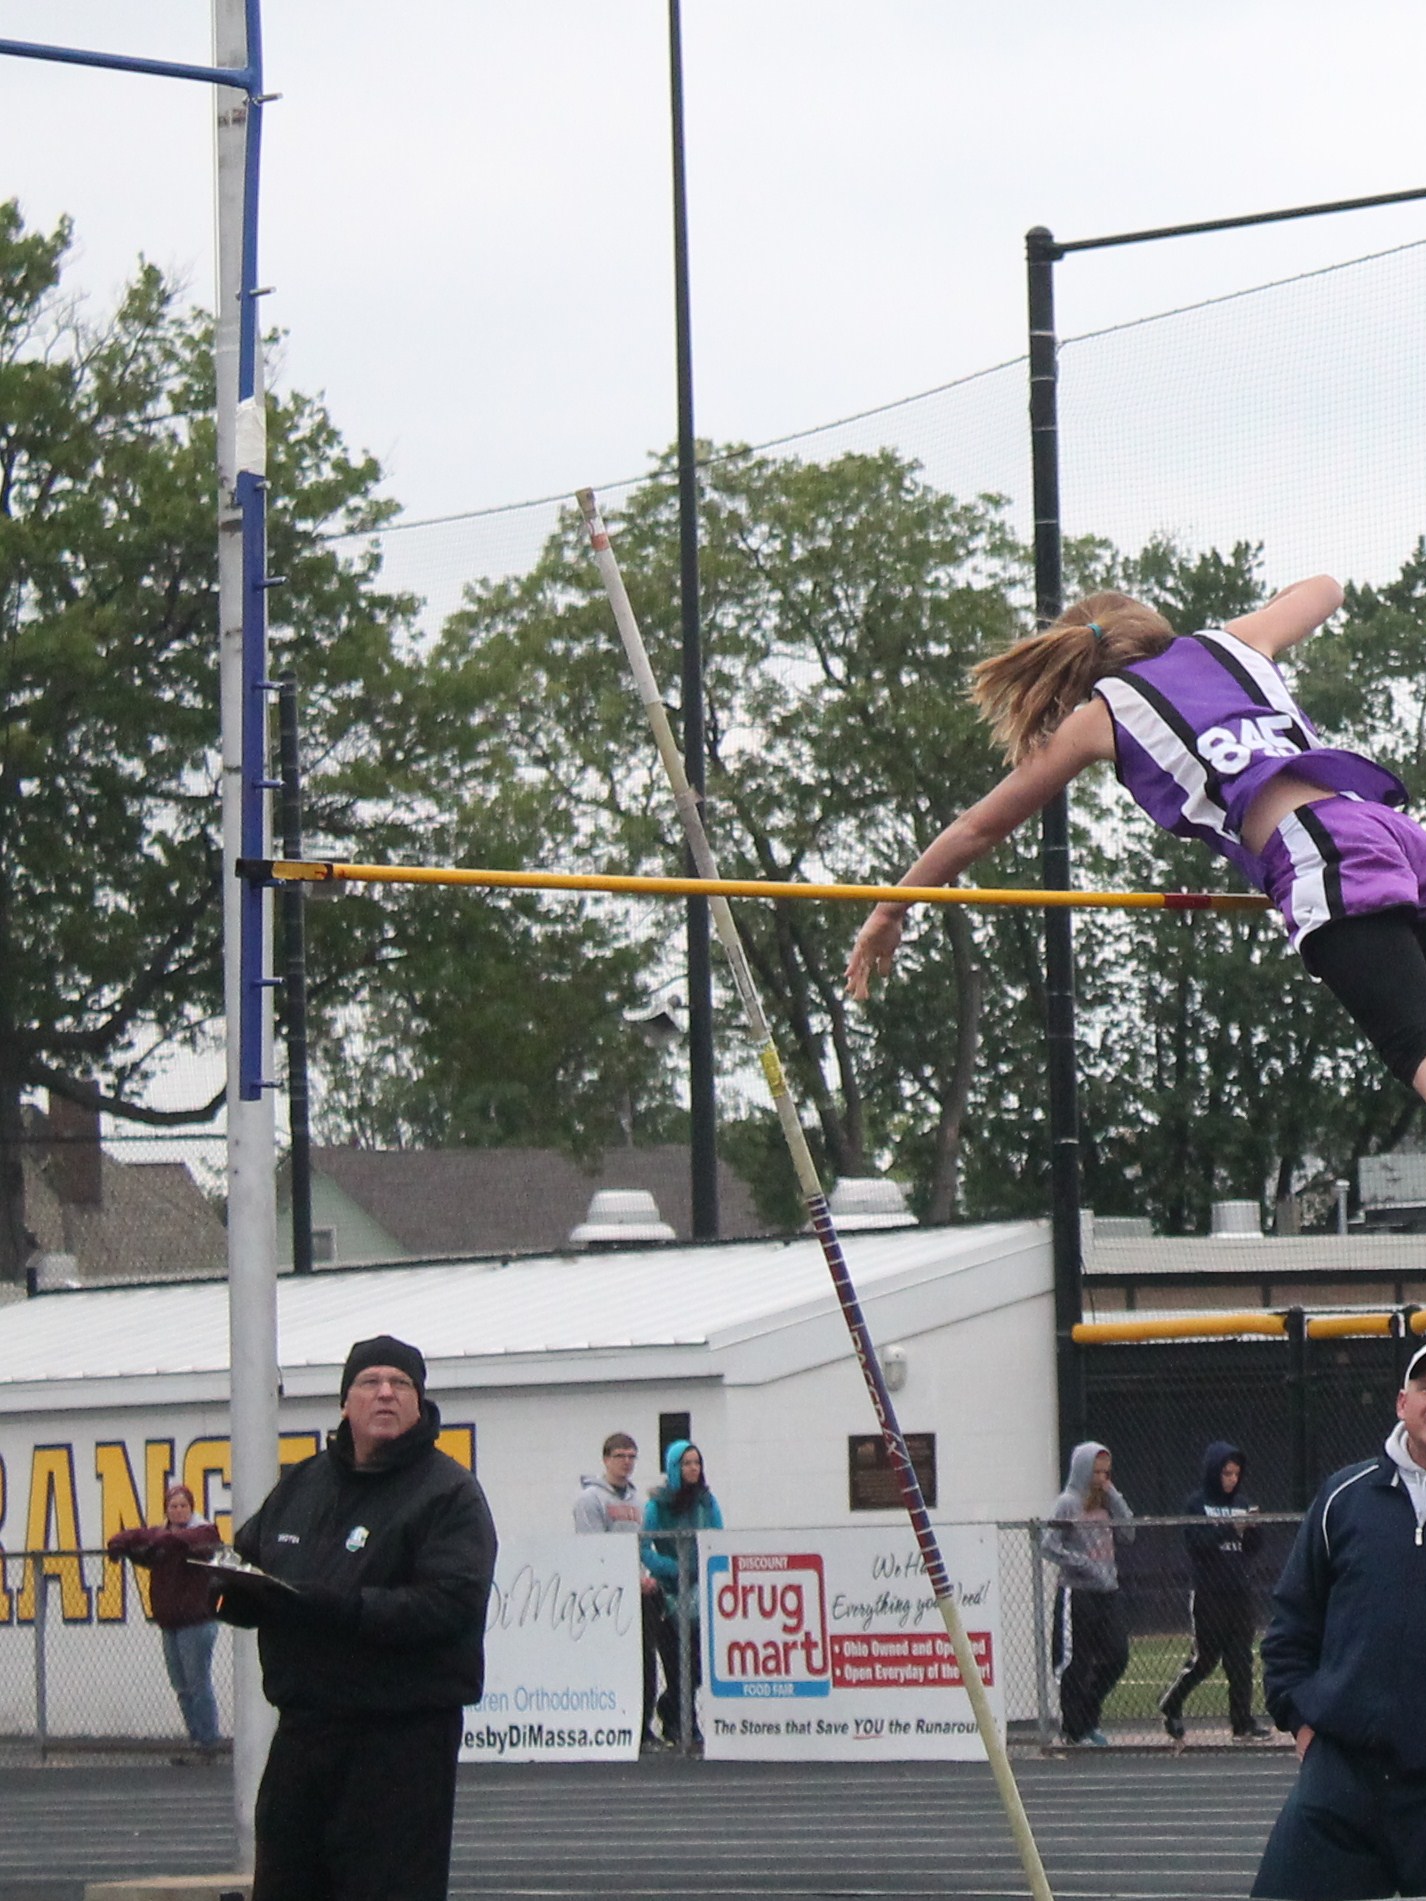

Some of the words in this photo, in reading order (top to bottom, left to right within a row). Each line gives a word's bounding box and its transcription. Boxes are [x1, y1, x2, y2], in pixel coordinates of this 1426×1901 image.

[1197, 714, 1302, 775] 845
[738, 1556, 789, 1570] DISCOUNT
[905, 1551, 928, 1578] Ha
[717, 1582, 805, 1635] drug
[832, 1591, 911, 1632] Everything
[727, 1631, 828, 1677] mart
[843, 1640, 869, 1657] Ohio
[871, 1640, 909, 1657] Owned
[911, 1640, 933, 1656] and
[844, 1664, 872, 1683] Open
[875, 1663, 925, 1683] Everyday
[927, 1662, 939, 1679] of
[942, 1662, 960, 1679] the
[513, 1685, 617, 1713] Orthodontics
[743, 1683, 771, 1696] FOOD
[772, 1683, 796, 1696] FAIR
[460, 1722, 633, 1755] esbyDiMassa.com
[713, 1719, 737, 1735] The
[740, 1719, 782, 1735] Stores
[785, 1720, 812, 1735] that
[815, 1719, 849, 1735] Save
[853, 1719, 884, 1736] YOU
[888, 1719, 911, 1735] the
[915, 1718, 980, 1735] Runarou
